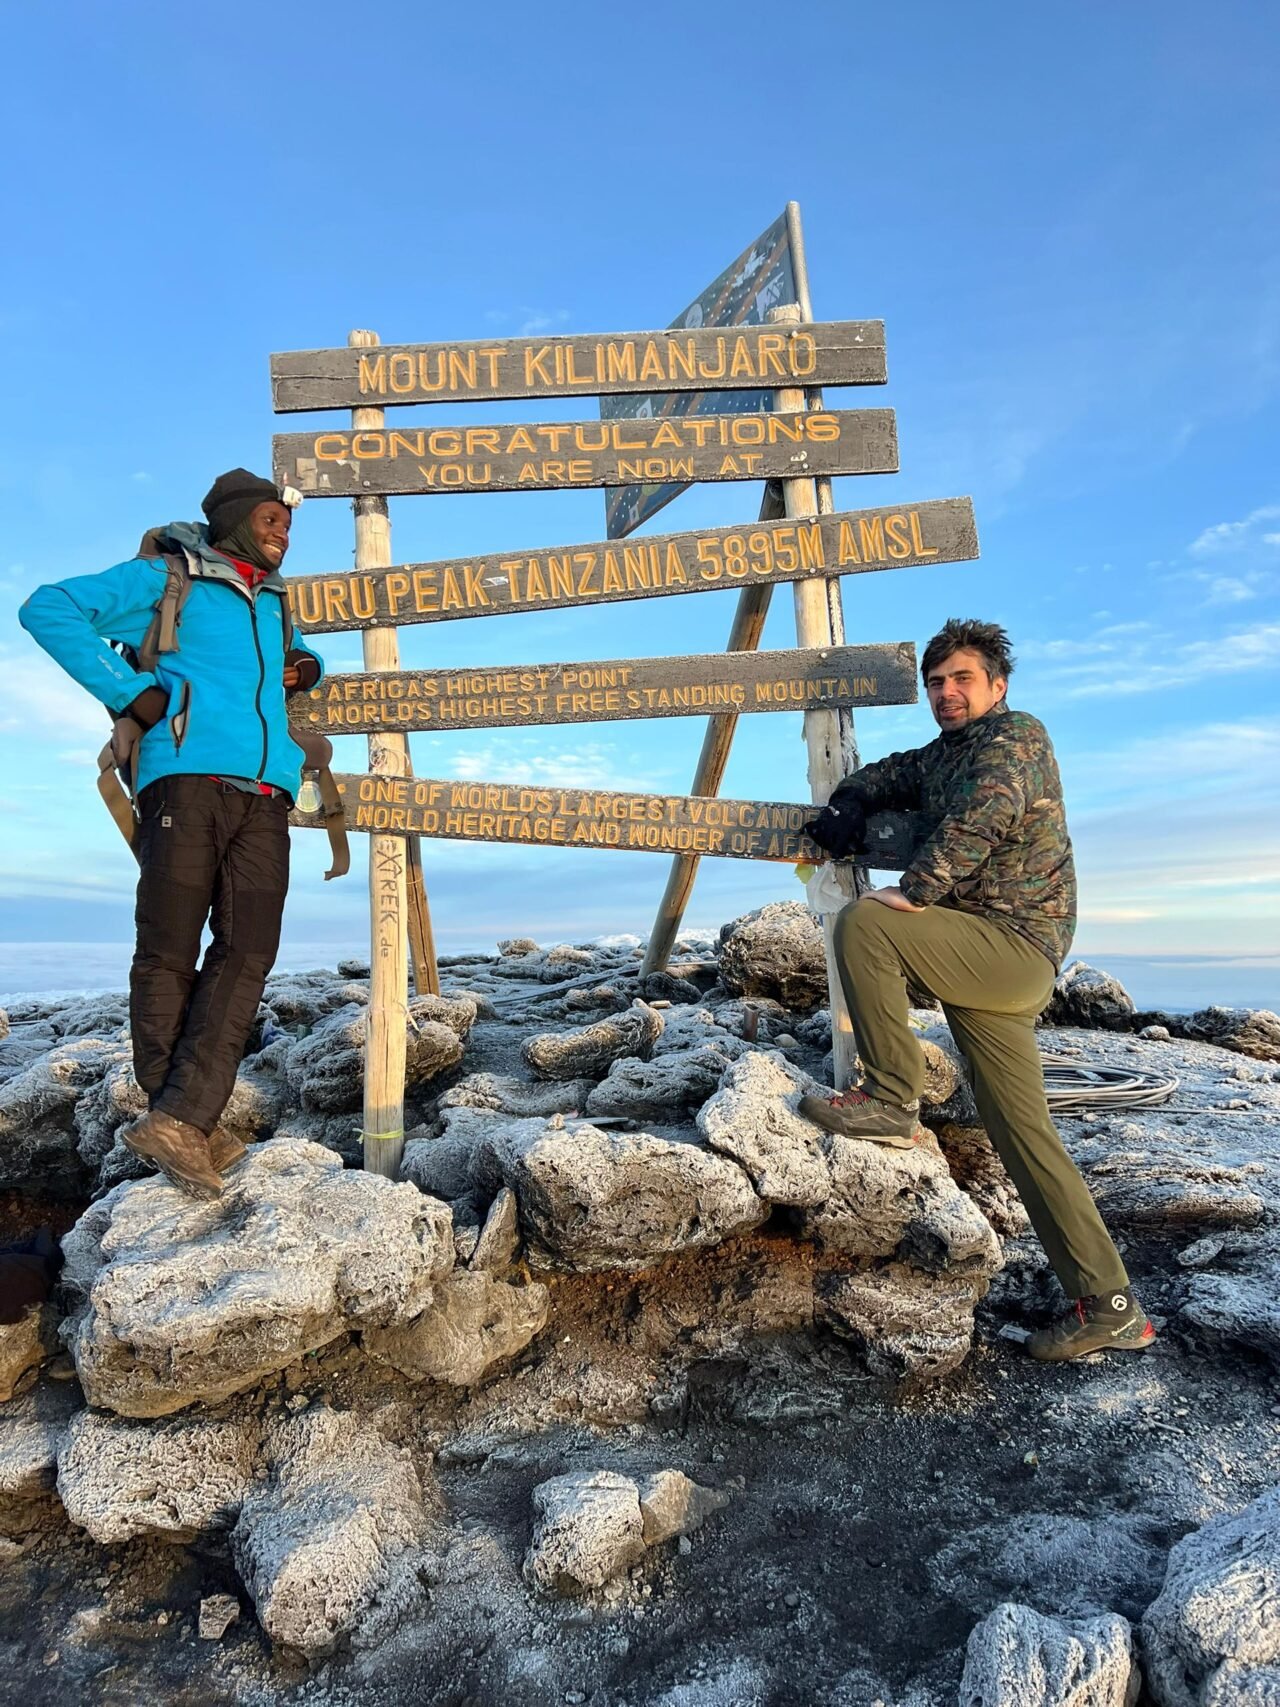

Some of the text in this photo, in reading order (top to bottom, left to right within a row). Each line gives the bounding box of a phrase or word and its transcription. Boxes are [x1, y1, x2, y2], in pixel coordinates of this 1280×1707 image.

[359, 332, 817, 395] MOUNT KILIMANJARO
[314, 414, 841, 462] CONGRATULATIONS
[418, 453, 763, 486] YOU ARE NOW AT
[286, 575, 377, 625] URU
[697, 524, 826, 581] 5895M
[838, 511, 938, 566] AMSL
[440, 694, 547, 720] HIGHEST
[556, 689, 620, 714] FREE
[626, 683, 746, 710] STANDING
[755, 676, 878, 703] MOUNTAIN
[447, 672, 550, 697] HIGHEST
[562, 667, 632, 690] POINT
[359, 779, 409, 804] ONE
[415, 783, 444, 806] OF
[559, 793, 681, 823] LARGEST
[355, 804, 440, 833] WORLD
[445, 812, 568, 841] HERITAGE
[573, 821, 621, 845] AND
[628, 823, 725, 851] WONDER
[731, 832, 762, 854] OF
